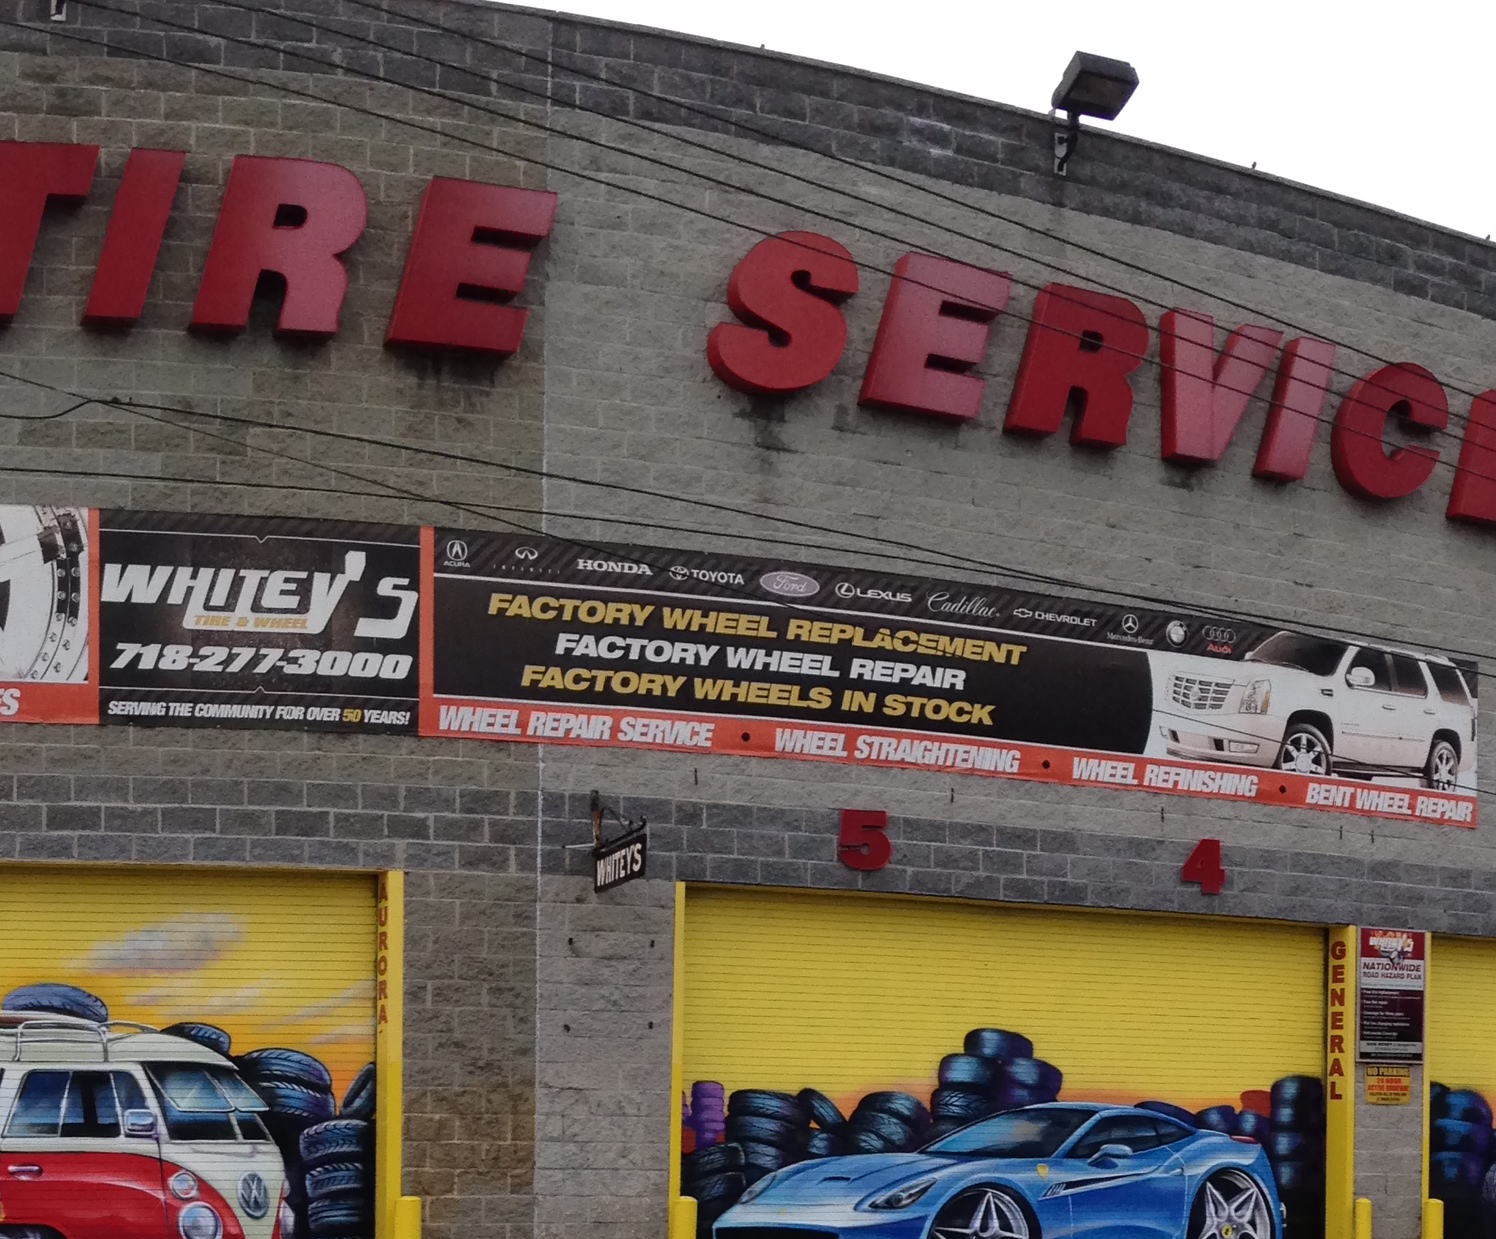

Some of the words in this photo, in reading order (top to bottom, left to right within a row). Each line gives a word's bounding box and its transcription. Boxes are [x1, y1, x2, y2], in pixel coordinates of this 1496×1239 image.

[576, 558, 654, 575] HONDA
[690, 568, 745, 585] TOYOTA
[772, 573, 808, 593] Ford
[101, 551, 419, 638] WHITEY'S
[856, 588, 913, 602] LEXUS
[926, 590, 998, 618] Cadillac
[194, 615, 231, 627] TIRE
[236, 616, 249, 627] &
[253, 617, 309, 630] WHEEL
[489, 592, 655, 627] FACTORY
[661, 601, 777, 638] WHEEL
[787, 618, 1027, 666] REPLACEMENT
[1034, 611, 1098, 627] CHEVROLET
[109, 642, 413, 680] 718-277-3000
[555, 633, 720, 667] FACTORY
[725, 647, 840, 679] WHEEL
[850, 659, 966, 691] REPAIR
[1207, 643, 1232, 654] Audi
[108, 700, 167, 716] SERVING
[168, 702, 193, 717] THE
[194, 703, 274, 720] COMMUNITY
[276, 705, 305, 721] FOR
[306, 707, 341, 722] OVER
[342, 707, 362, 723] 50
[363, 708, 410, 725] YEARS!
[521, 664, 687, 697] FACTORY
[694, 678, 832, 710] WHEELS
[841, 689, 876, 713] IN
[882, 693, 996, 726] STOCK
[438, 705, 522, 736] WHEEL
[527, 711, 613, 741] REPAIR
[617, 718, 715, 747] SERVICE
[775, 727, 848, 758] WHEEL
[854, 733, 1021, 774] STRAIGHTENING
[1072, 756, 1139, 786] WHEEL
[1143, 762, 1259, 797] REFINISHING
[1306, 782, 1352, 808] BENT
[1355, 786, 1412, 816] WHEEL
[1415, 796, 1472, 822] REPAIR
[837, 808, 892, 870] 5
[1181, 838, 1226, 895] 4
[377, 873, 389, 1025] AURORA
[1362, 962, 1422, 972] NATIONWIDE
[1362, 971, 1379, 979] ROAD
[1330, 941, 1347, 1101] GENERAL
